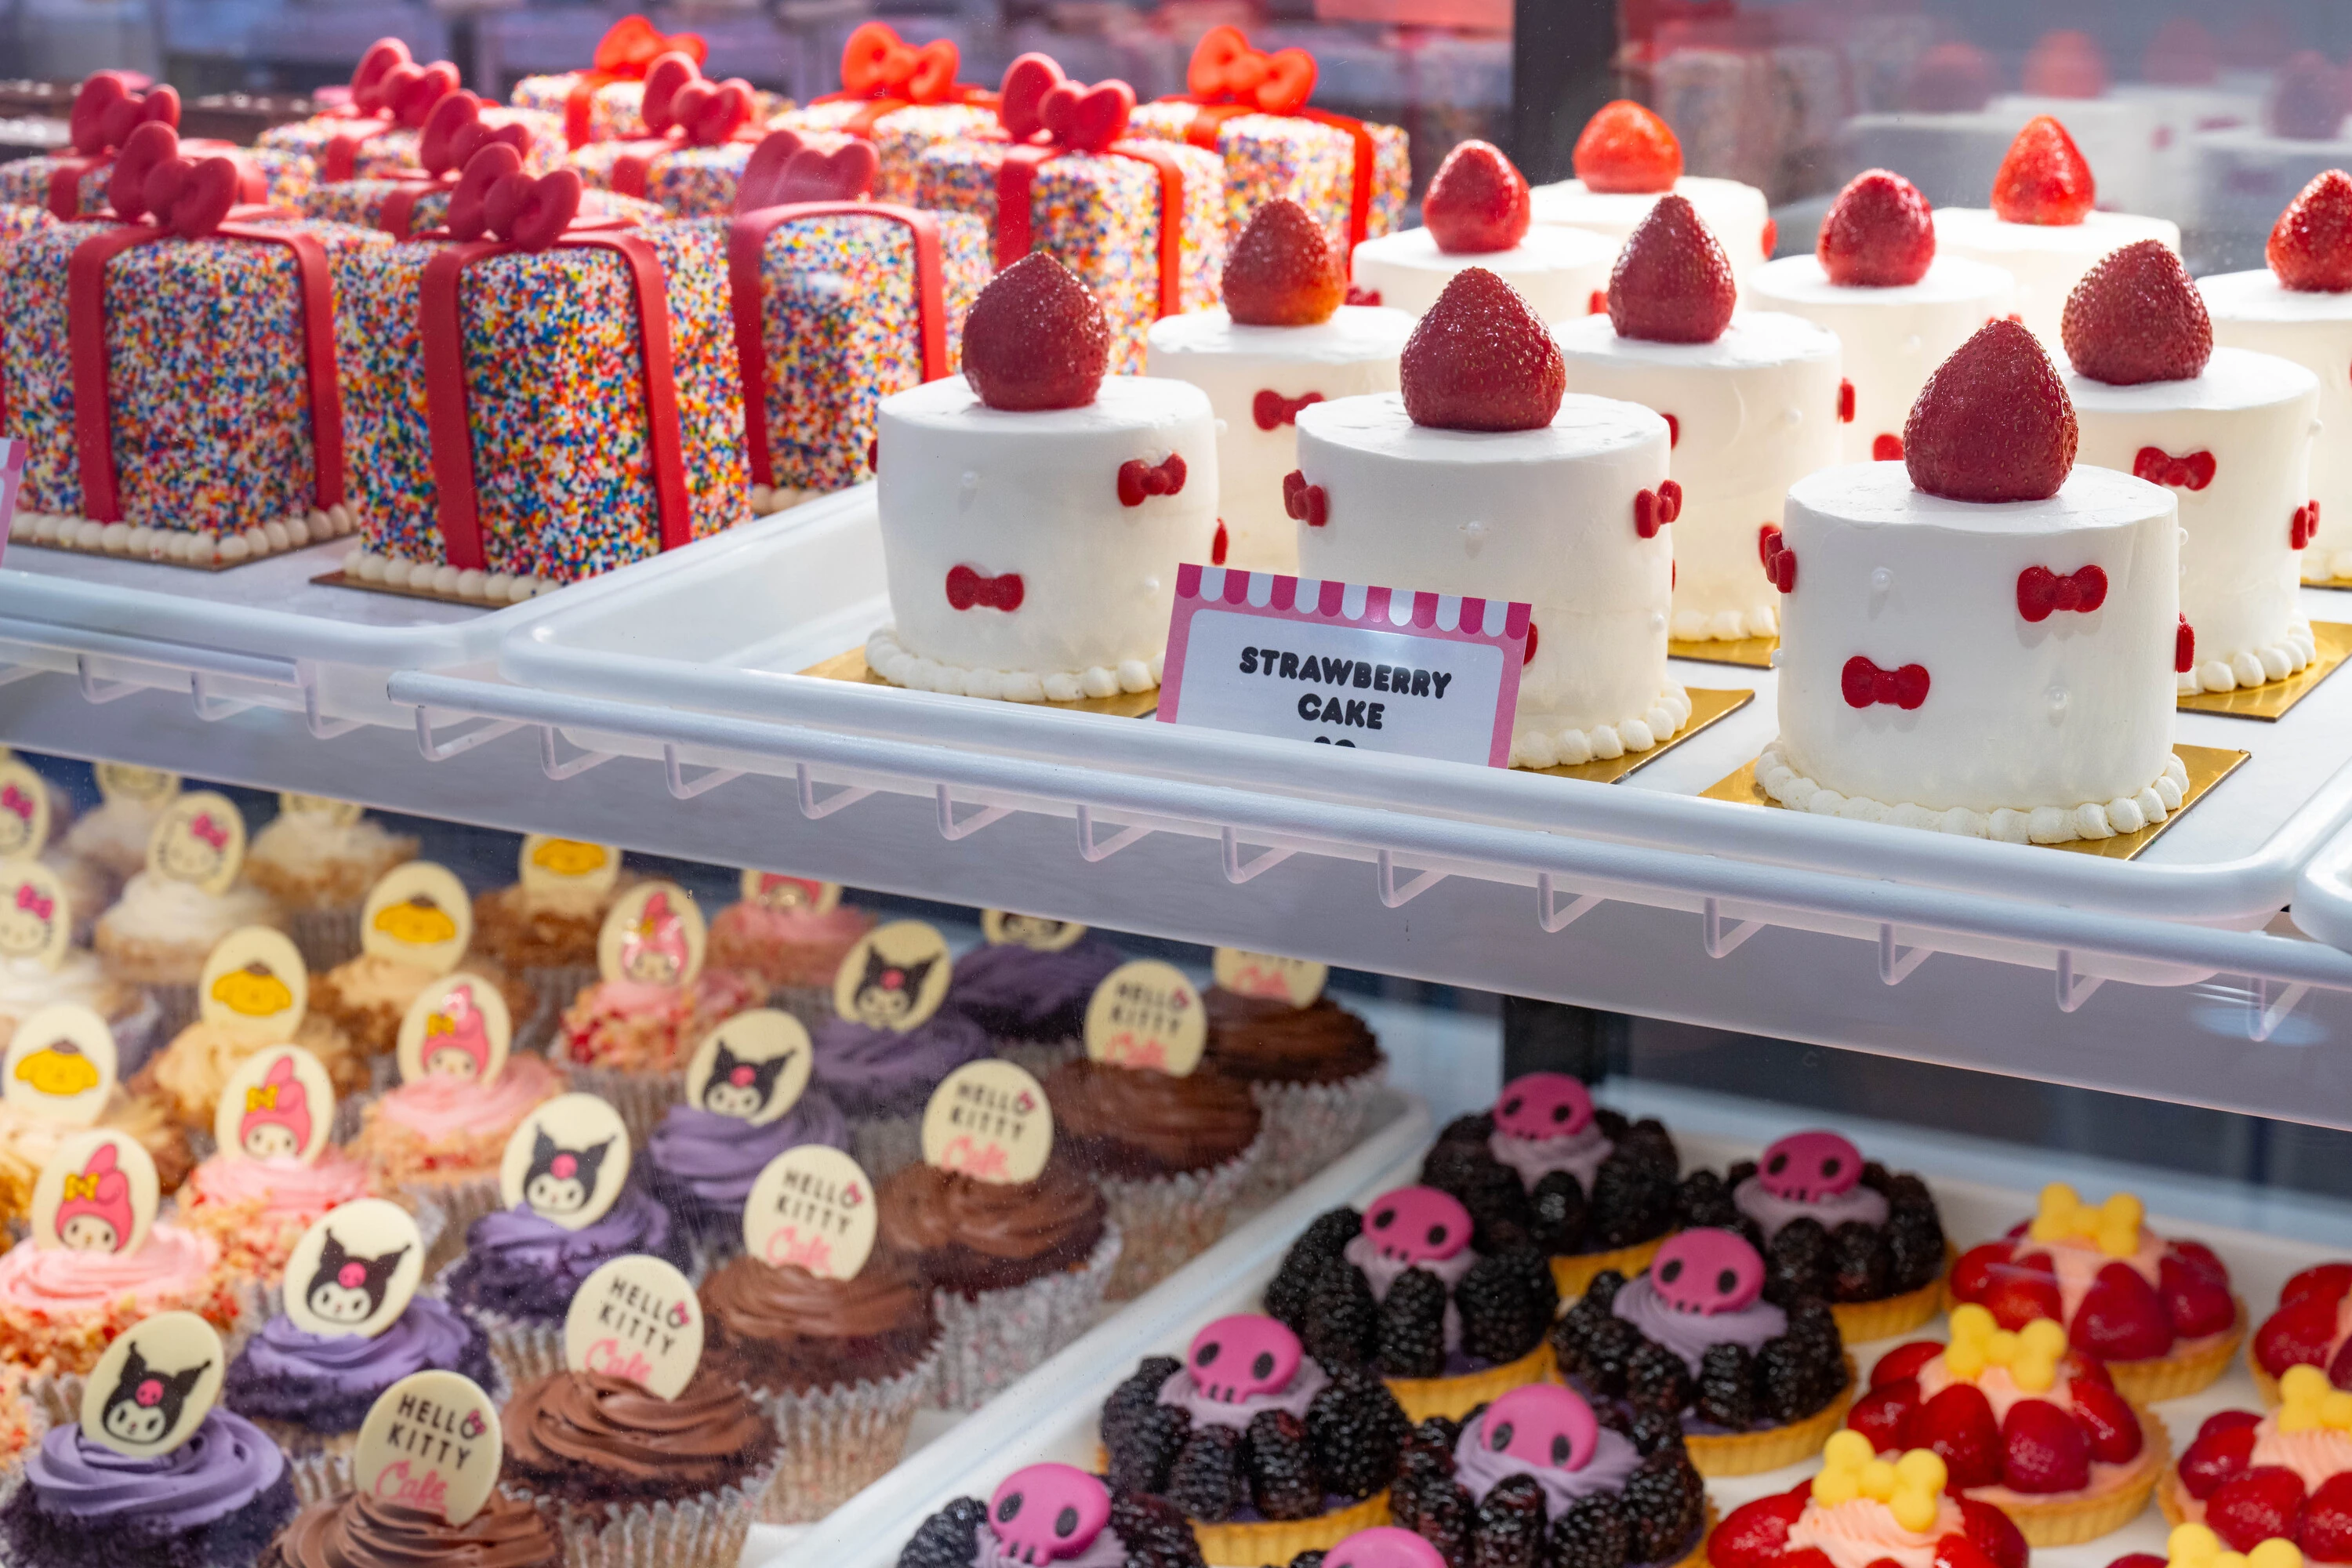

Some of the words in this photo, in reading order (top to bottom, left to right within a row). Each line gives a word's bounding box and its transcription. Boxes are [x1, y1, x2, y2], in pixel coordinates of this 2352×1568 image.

[1239, 646, 1452, 699] STRAWBERRY
[1298, 693, 1385, 730] CAKE
[956, 1082, 1034, 1117] HELLO
[949, 1105, 1025, 1142] KITTY
[784, 1167, 862, 1209] HELLO
[775, 1192, 852, 1236] KITTY
[610, 1276, 688, 1329] HELLO
[599, 1302, 675, 1356] KITTY
[397, 1392, 484, 1439] HELLO
[387, 1421, 471, 1470] KITTY
